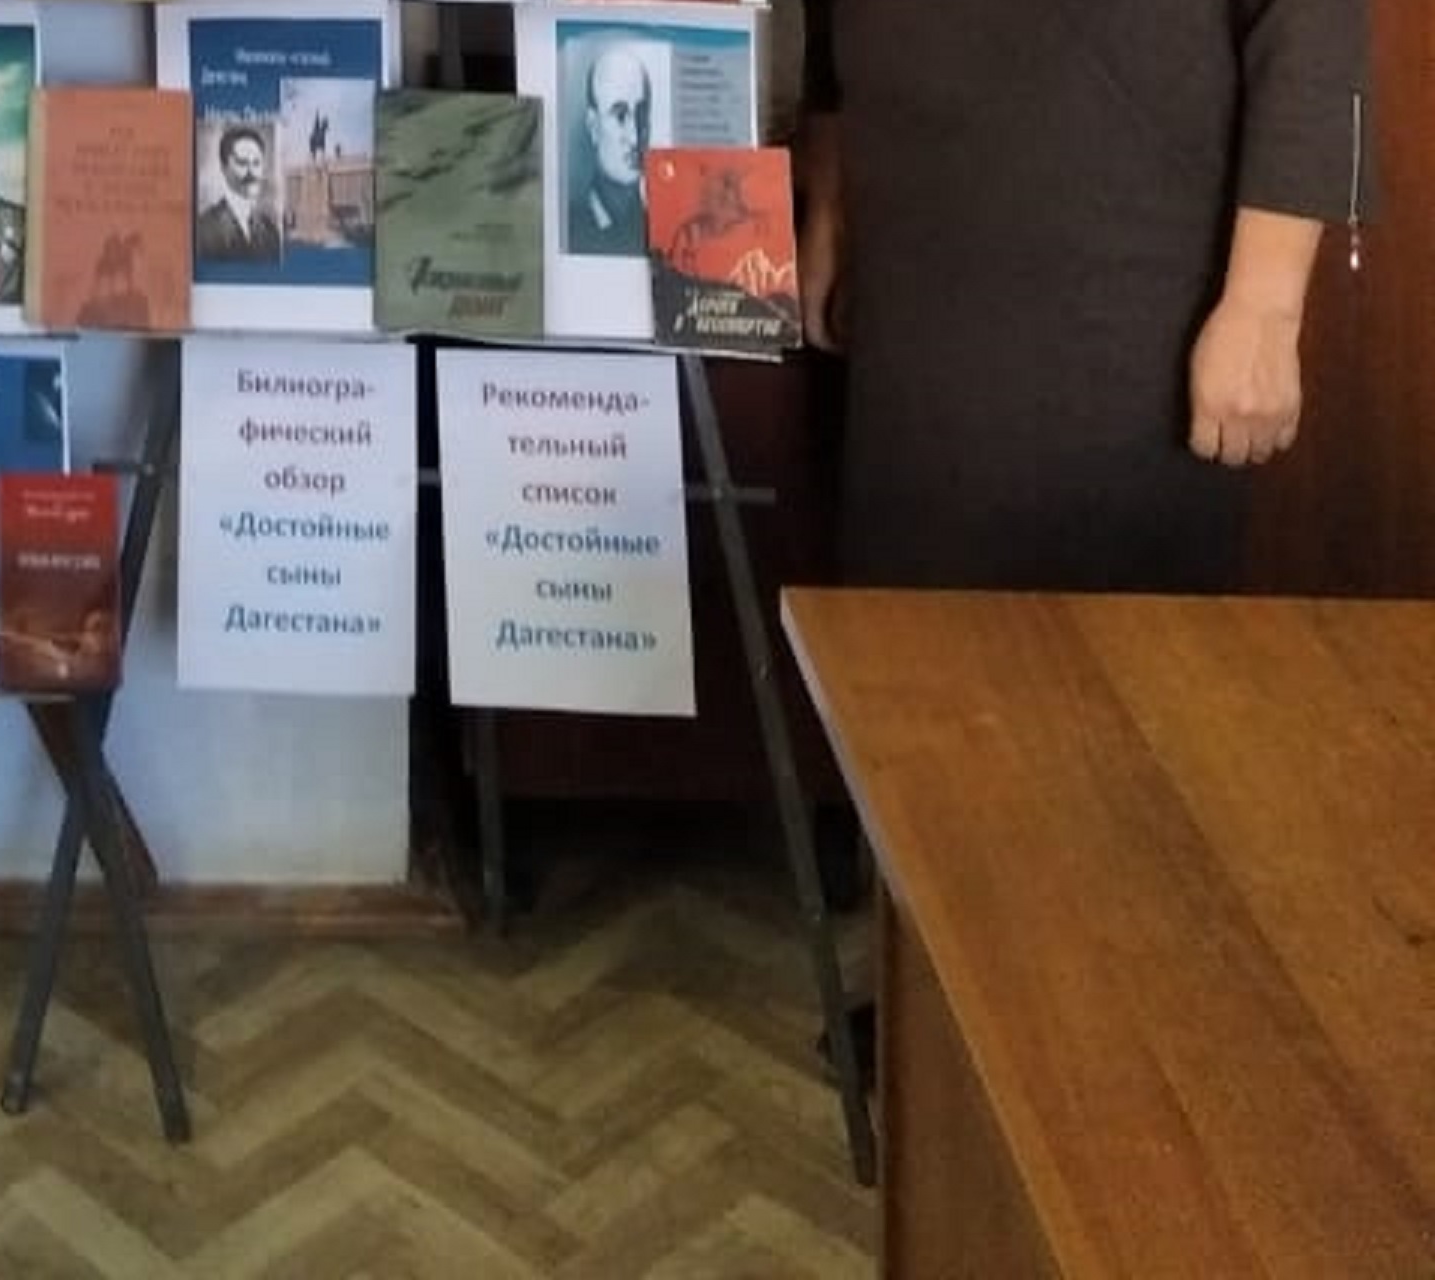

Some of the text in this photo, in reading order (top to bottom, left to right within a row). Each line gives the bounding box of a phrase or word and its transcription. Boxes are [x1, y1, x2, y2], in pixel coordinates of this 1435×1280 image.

[236, 368, 375, 402] Билиогра-
[482, 382, 650, 415] Рекоменда-
[238, 417, 372, 447] фический
[508, 433, 627, 459] тельный
[263, 467, 346, 497] обзор
[521, 484, 617, 506] список
[219, 511, 390, 541] «Достойные
[485, 524, 661, 556] «Достойные
[266, 565, 342, 586] сыны
[535, 580, 612, 602] сыны
[224, 603, 381, 634] Дагестана»
[496, 620, 658, 652] Дагестана»
